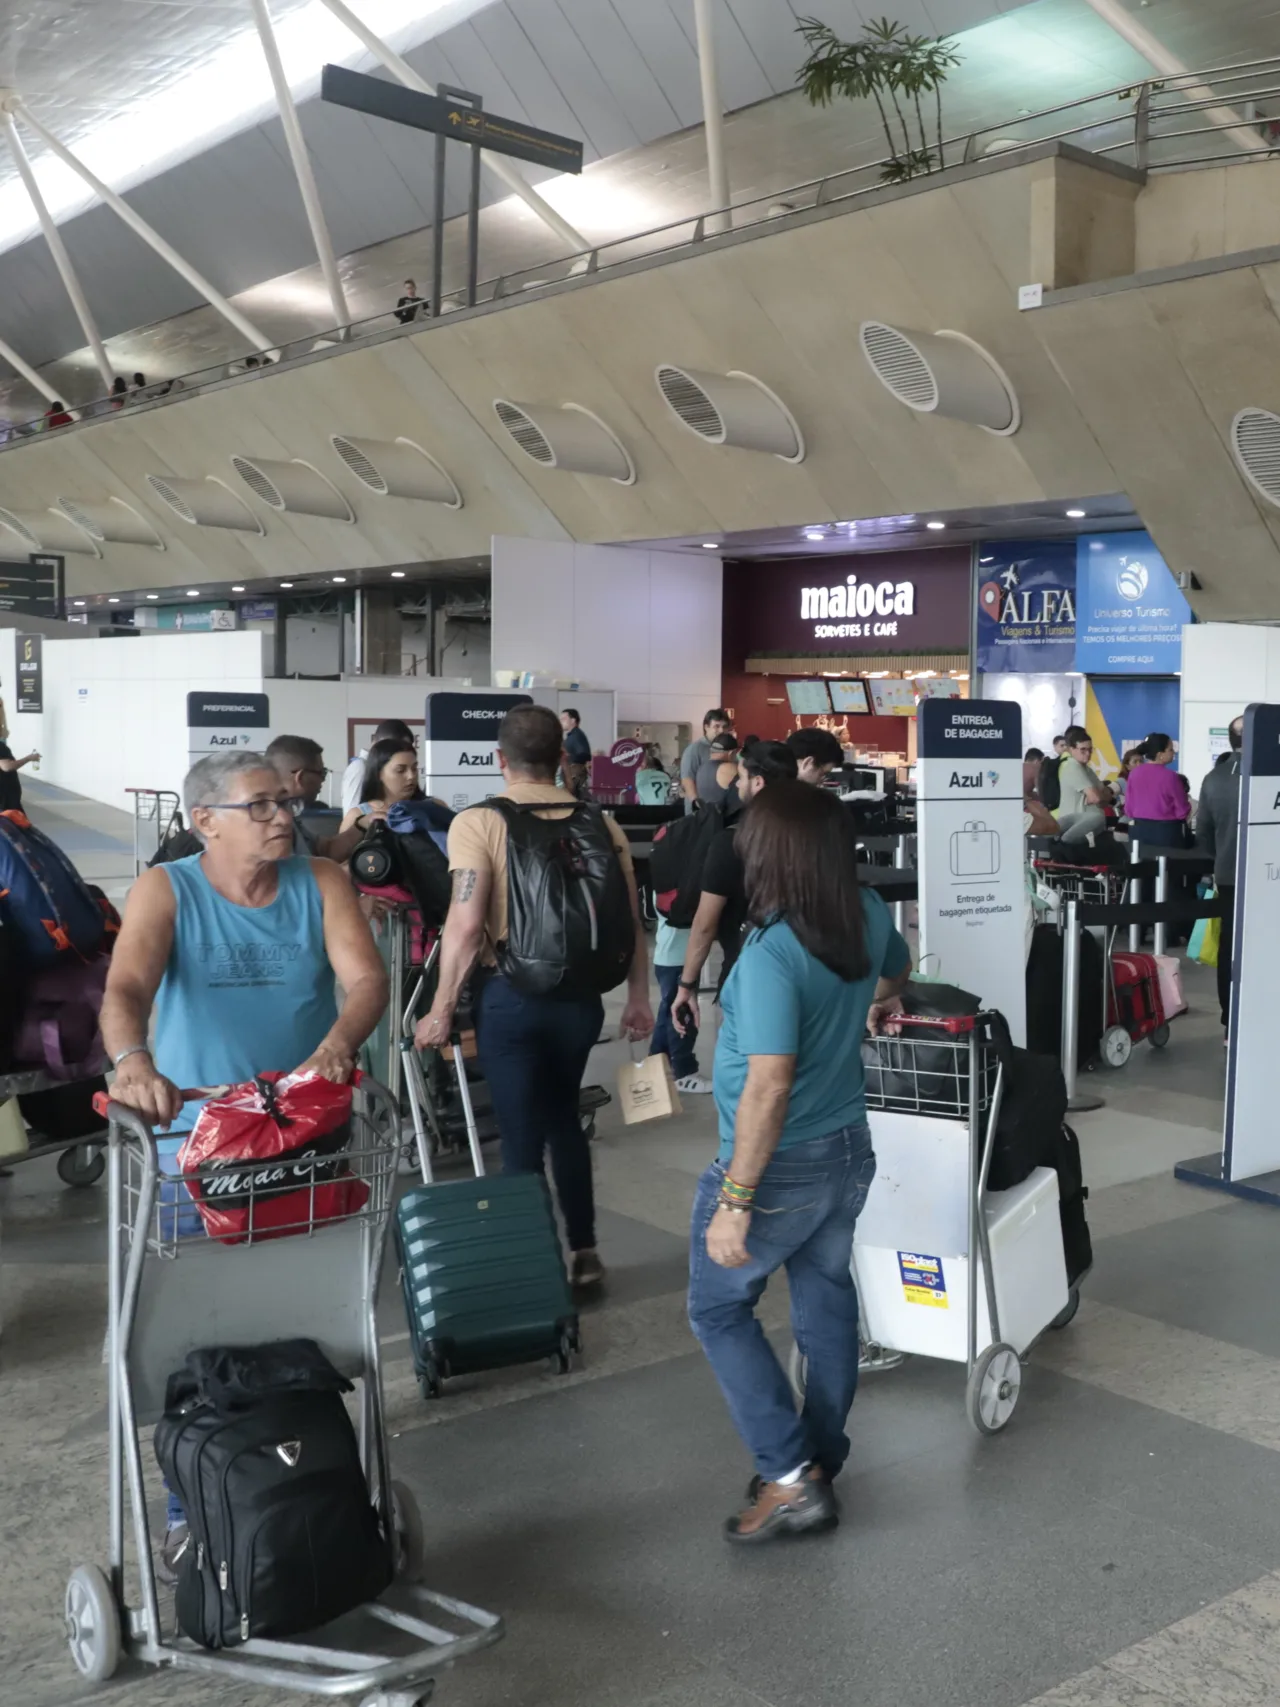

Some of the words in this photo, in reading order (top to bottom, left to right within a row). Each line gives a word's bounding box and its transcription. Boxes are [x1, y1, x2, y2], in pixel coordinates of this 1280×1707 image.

[801, 574, 915, 619] maioca
[999, 589, 1076, 624] ALFA
[1094, 608, 1133, 619] Universo
[1135, 606, 1170, 617] Turismo
[814, 624, 861, 638] SORVETES
[864, 623, 870, 636] E
[873, 621, 898, 636] CAFÉ
[1001, 626, 1032, 638] Viagens
[1034, 625, 1042, 636] &
[1044, 625, 1075, 636] Turismo
[202, 704, 256, 712] PREFERENCIAL
[952, 715, 994, 725] ENTREGA
[209, 734, 237, 745] Azul
[944, 728, 957, 738] DE
[959, 729, 1003, 739] BAGAGEM
[458, 752, 493, 766] Azul
[948, 771, 983, 788] Azul
[957, 895, 984, 904] Entrega
[986, 893, 995, 901] de
[939, 908, 973, 918] bagagem
[975, 904, 1012, 915] etiquetada
[197, 943, 301, 962] TOMMY
[210, 961, 285, 979] JEANS
